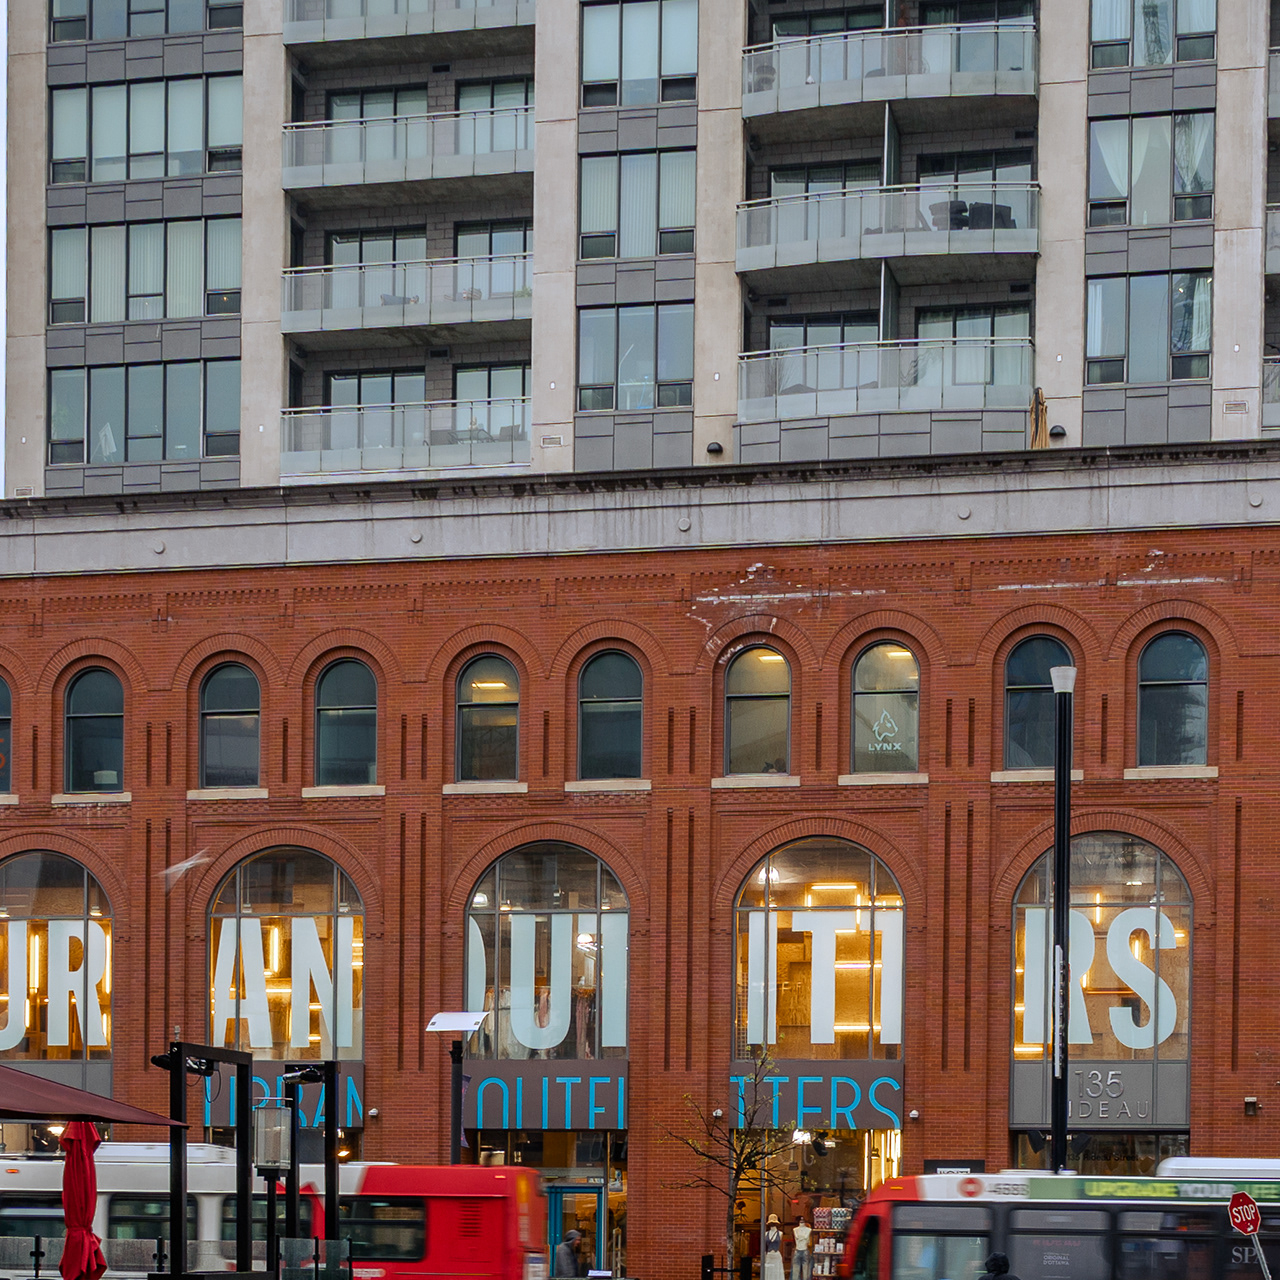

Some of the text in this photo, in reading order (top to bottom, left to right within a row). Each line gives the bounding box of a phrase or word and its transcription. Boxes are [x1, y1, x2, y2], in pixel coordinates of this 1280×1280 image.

[868, 742, 902, 751] LYNX
[1075, 1070, 1124, 1098] 135
[1069, 1100, 1150, 1118] IDEAU
[1083, 1151, 1112, 1162] Rideau
[1114, 1151, 1139, 1162] Street
[1232, 1203, 1257, 1223] STOP
